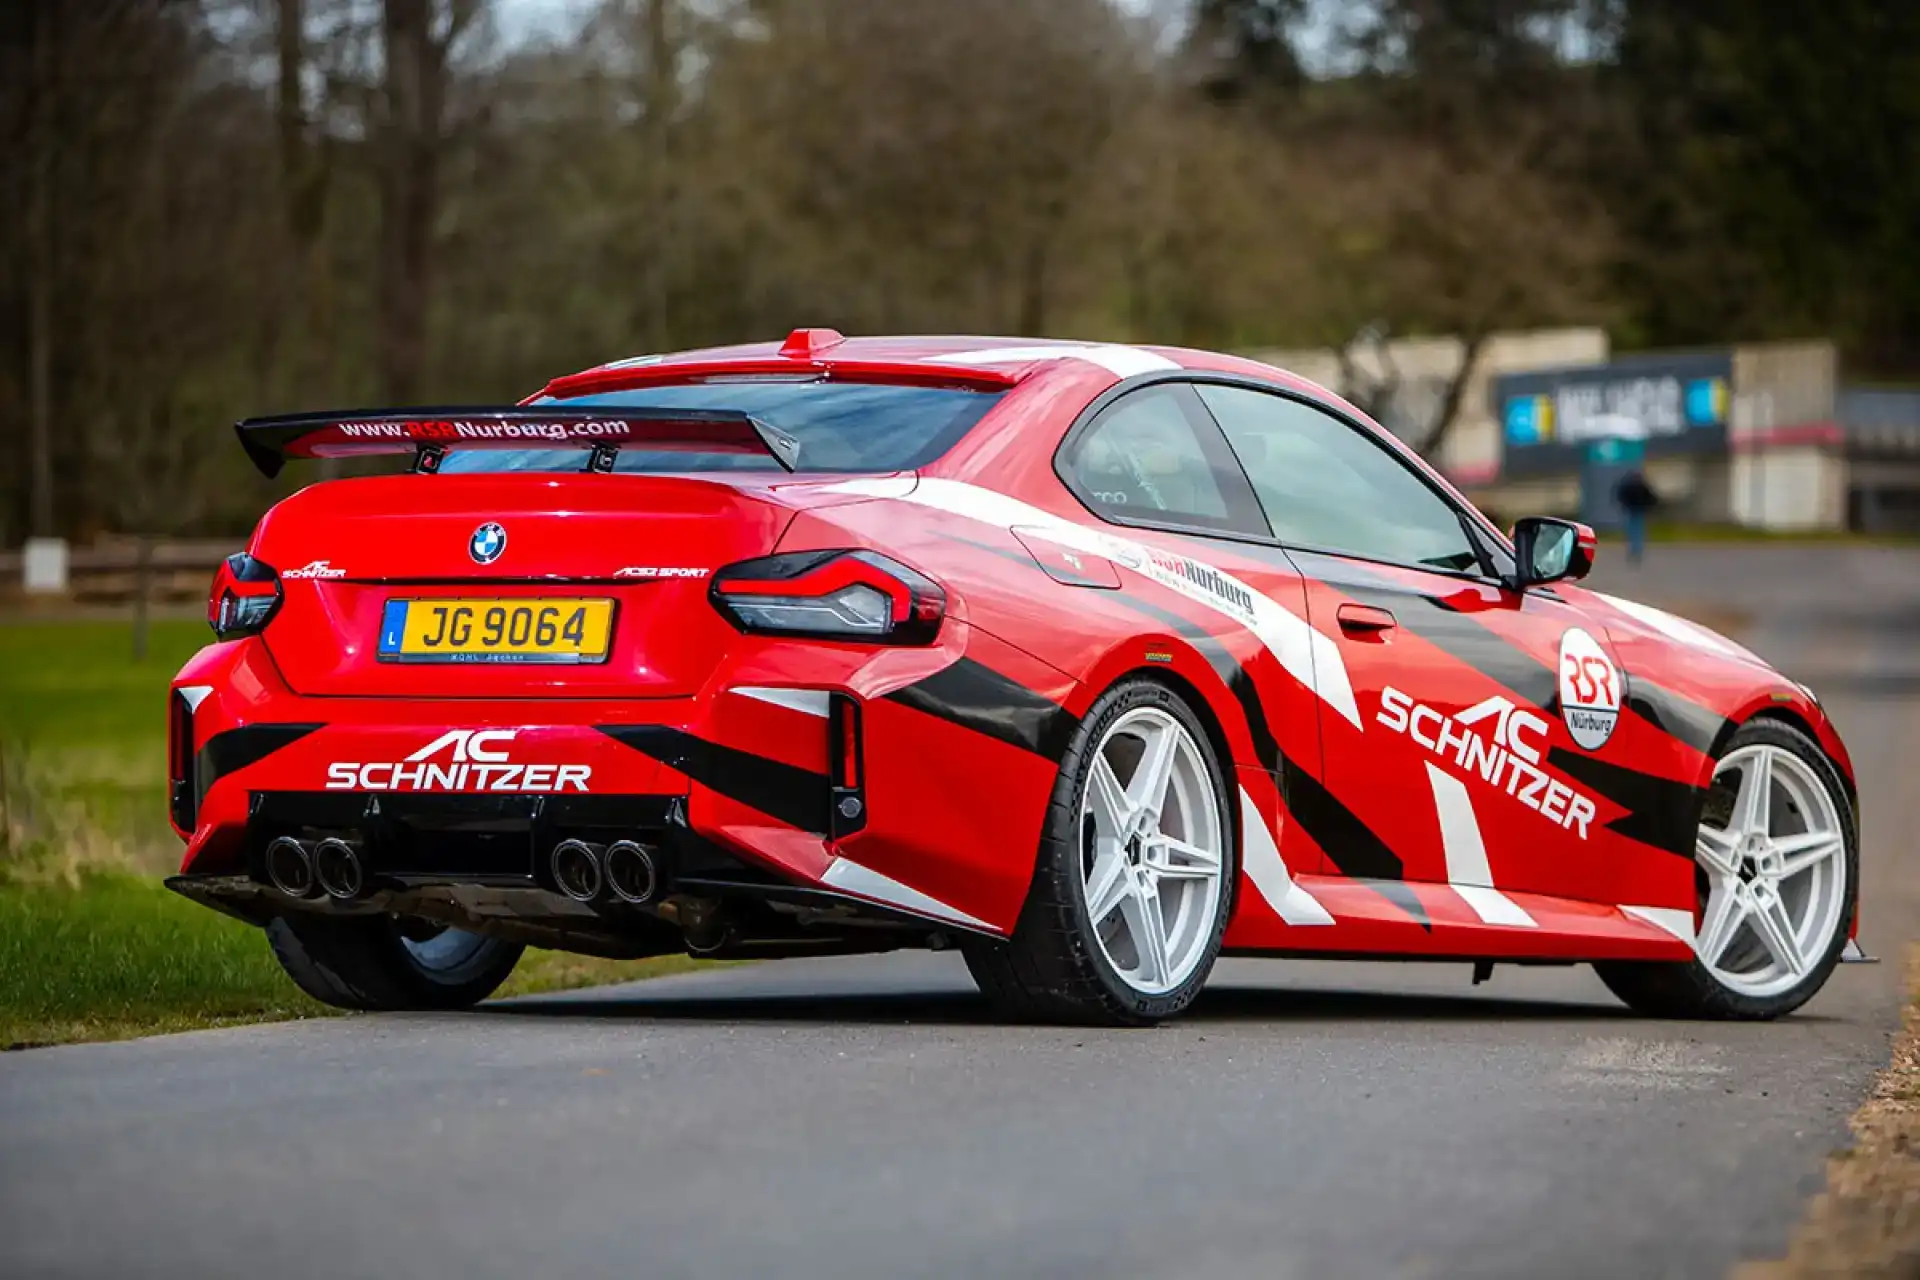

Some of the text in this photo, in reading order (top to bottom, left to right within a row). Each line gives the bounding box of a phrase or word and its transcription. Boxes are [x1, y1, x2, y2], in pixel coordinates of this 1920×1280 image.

[338, 419, 630, 440] www.RSRNurburg.com
[658, 567, 710, 578] SPORT
[388, 631, 396, 646] L
[423, 607, 586, 647] JG 9064
[1564, 653, 1614, 706] RSR
[1452, 695, 1549, 765] AC
[1570, 711, 1612, 737] Nürburg
[403, 730, 517, 762] AC
[326, 762, 592, 792] SCHNITZER
[1376, 685, 1596, 840] SCHNITZER
